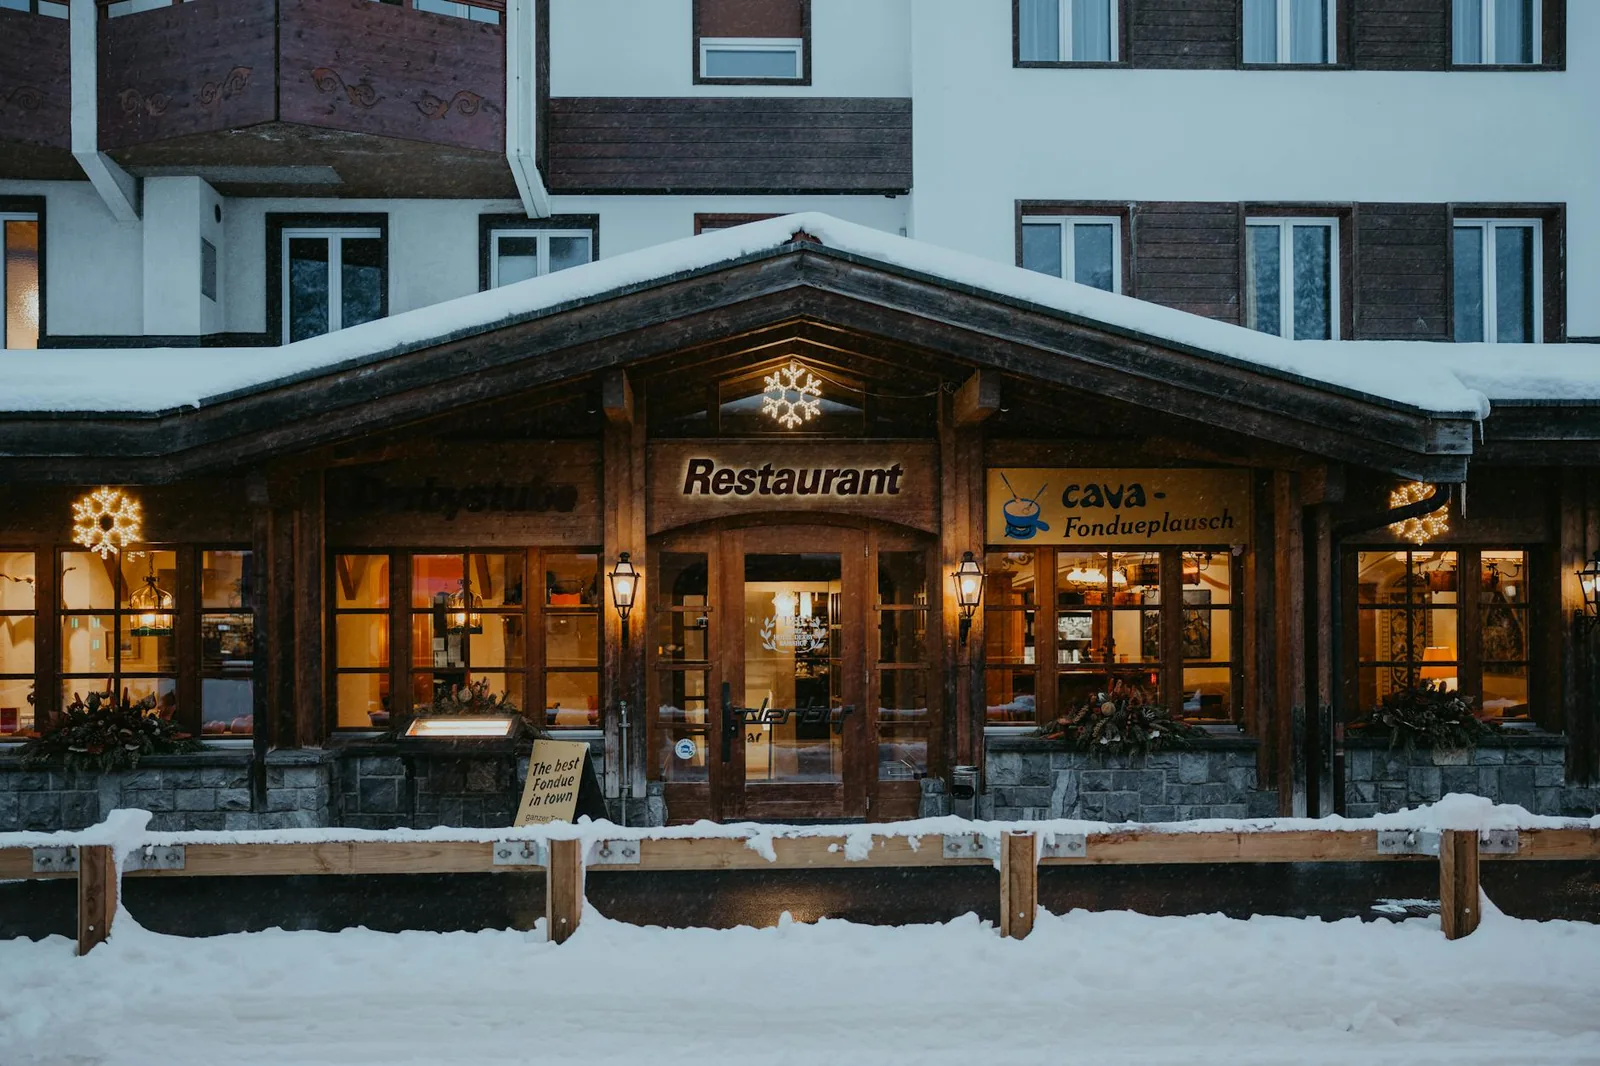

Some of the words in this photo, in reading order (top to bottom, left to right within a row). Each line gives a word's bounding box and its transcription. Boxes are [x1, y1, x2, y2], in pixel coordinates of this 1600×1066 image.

[683, 458, 904, 496] Restaurant
[1063, 509, 1234, 539] Fondueplausch
[532, 761, 552, 777] The
[554, 757, 580, 773] best
[532, 774, 575, 792] Fondue
[528, 793, 541, 807] in
[543, 792, 573, 805] town
